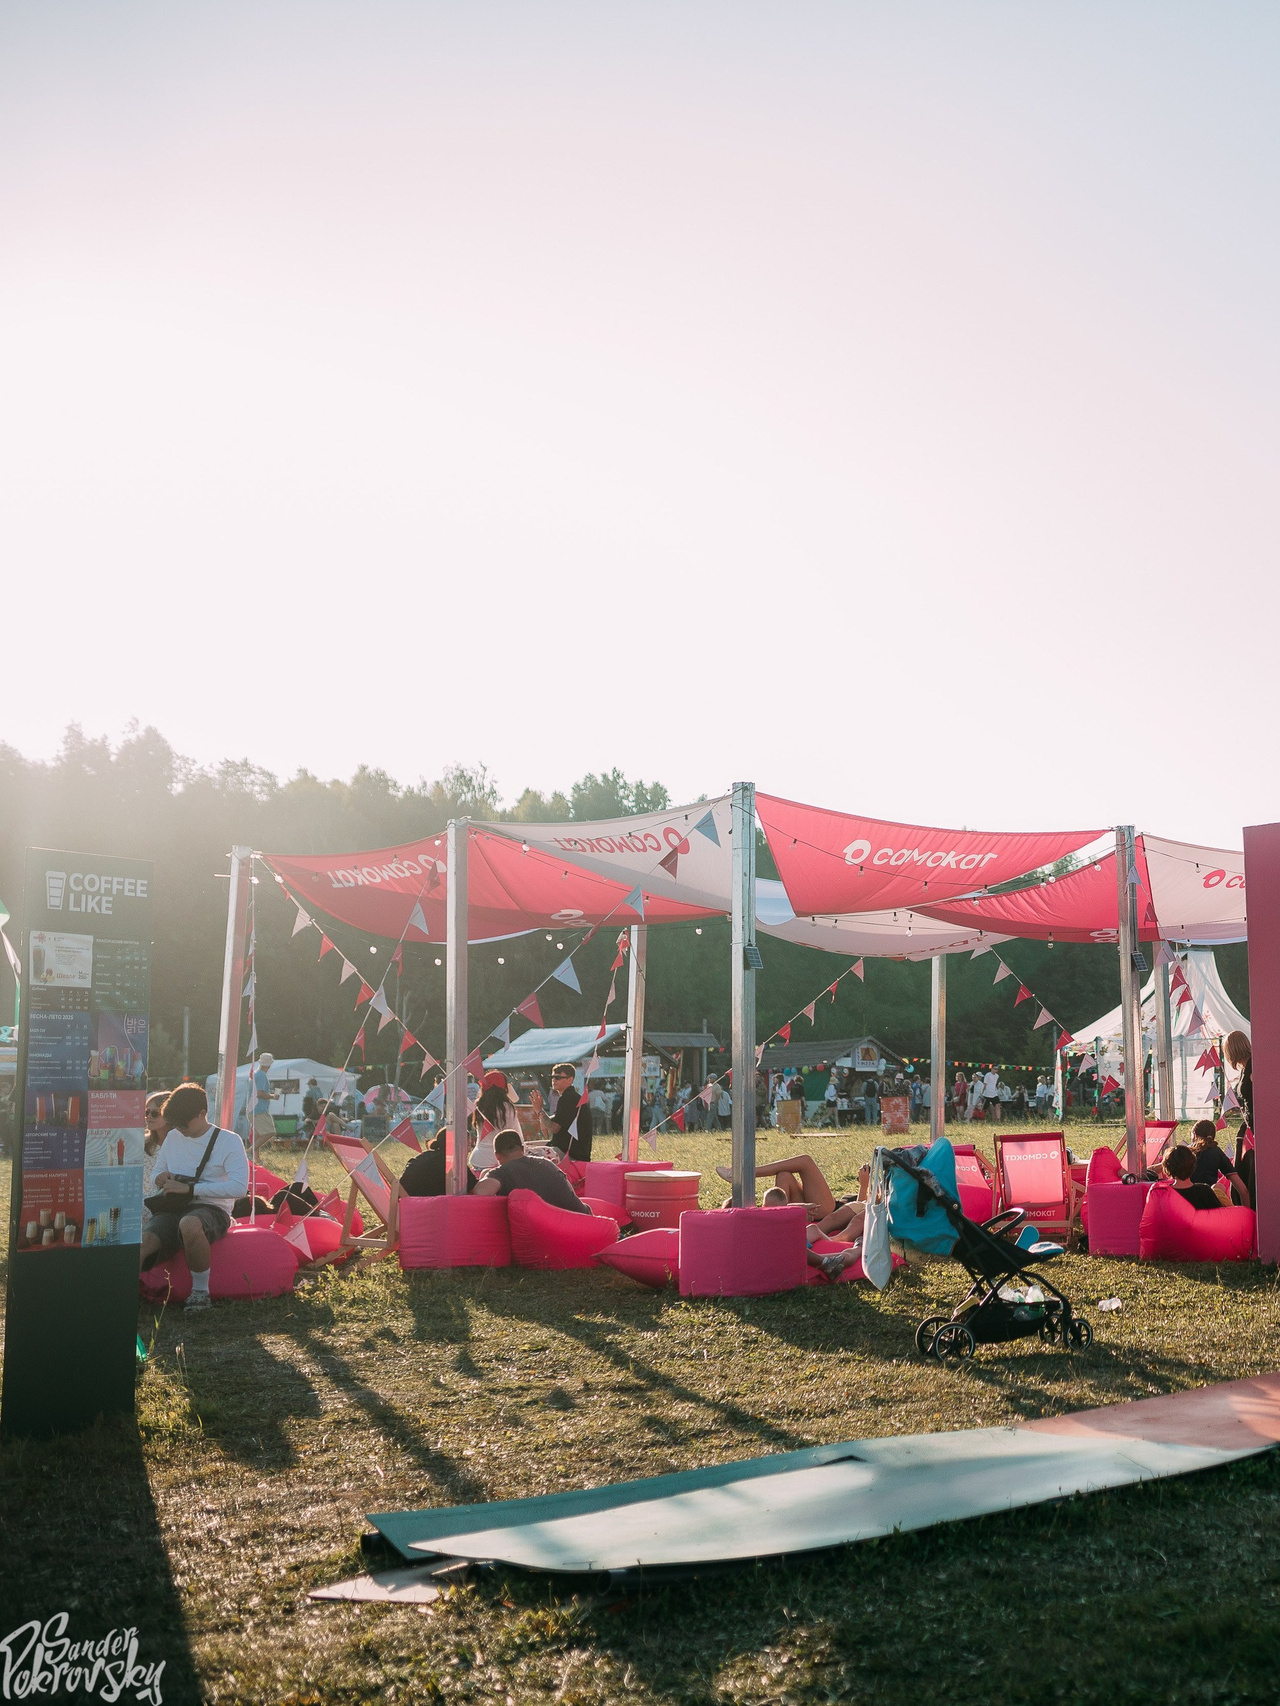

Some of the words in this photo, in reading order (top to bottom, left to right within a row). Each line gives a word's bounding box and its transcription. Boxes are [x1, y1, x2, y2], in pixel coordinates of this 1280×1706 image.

[872, 847, 999, 870] самокат
[69, 872, 148, 898] COFFEE
[68, 892, 114, 915] LIKE
[629, 1210, 661, 1218] амокат
